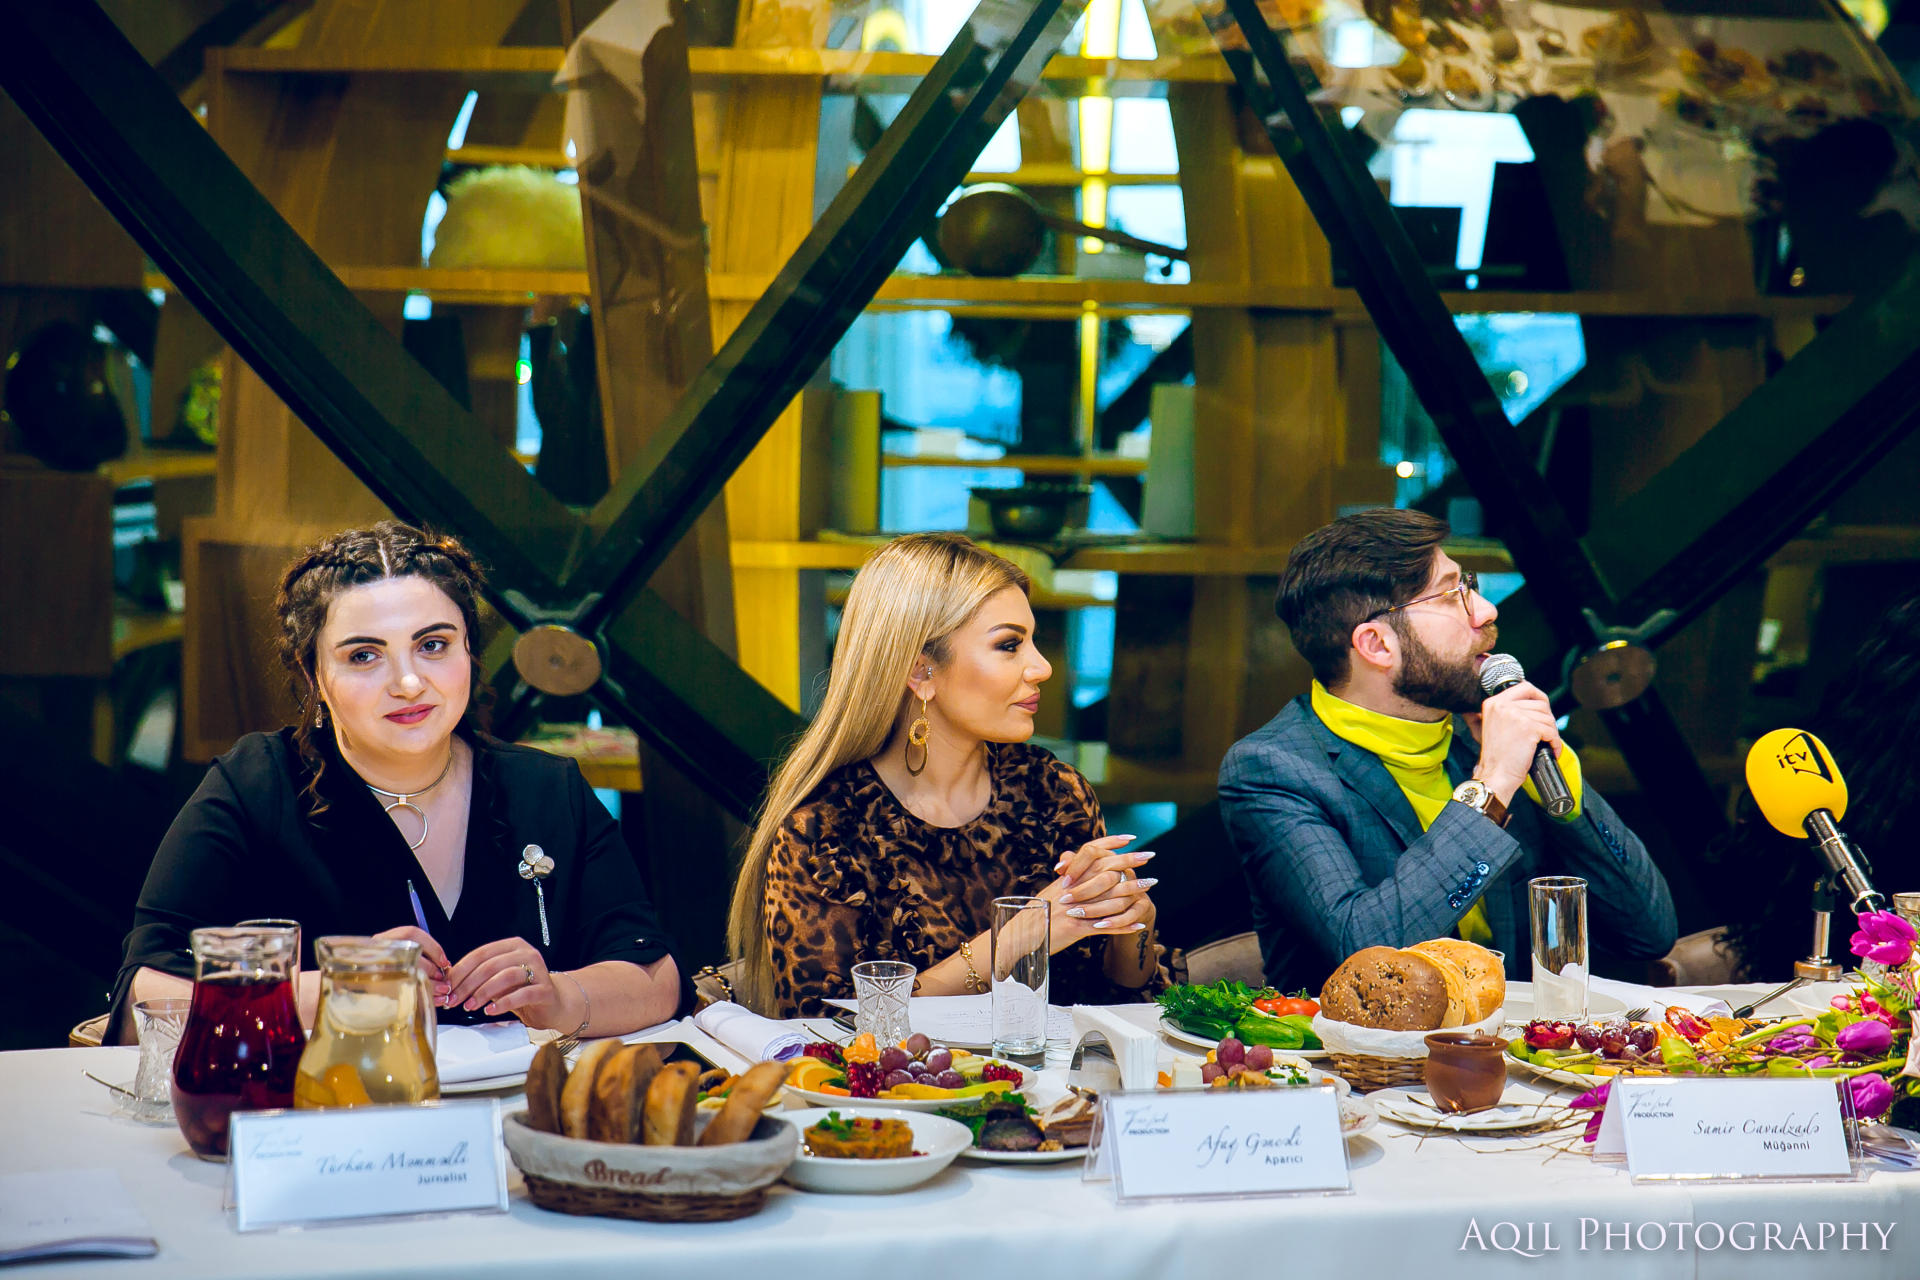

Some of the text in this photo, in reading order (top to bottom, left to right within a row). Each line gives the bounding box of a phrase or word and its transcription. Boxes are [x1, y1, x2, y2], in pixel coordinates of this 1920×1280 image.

[1776, 751, 1807, 769] itv
[1693, 1119, 1735, 1135] Samir
[418, 1172, 467, 1185] Jurnalist
[583, 1158, 673, 1186] Bread
